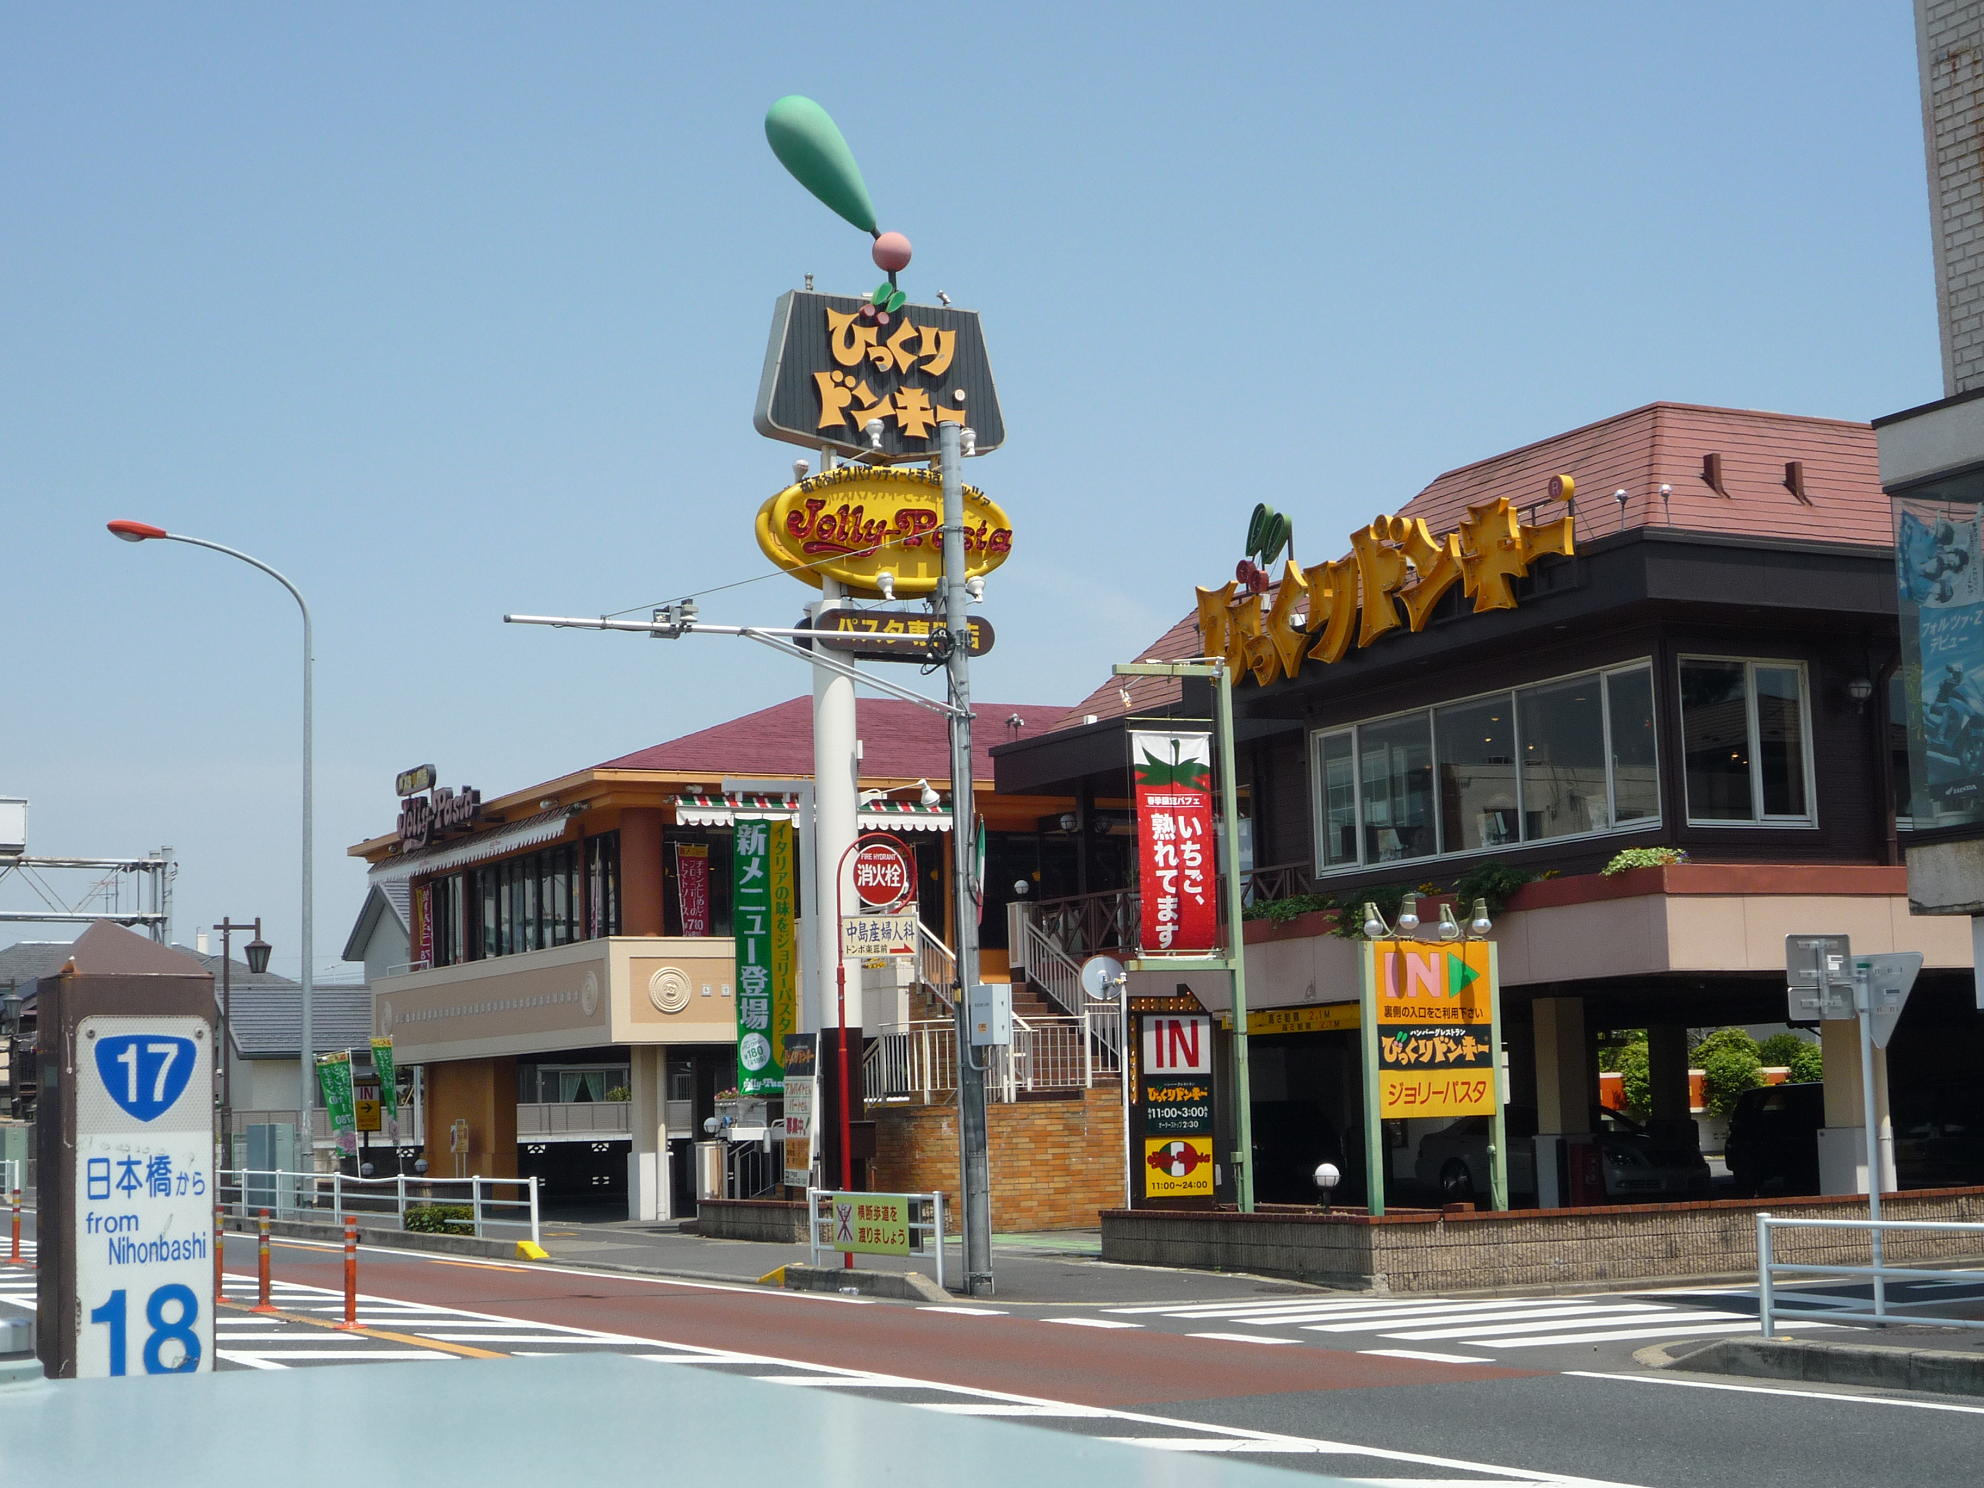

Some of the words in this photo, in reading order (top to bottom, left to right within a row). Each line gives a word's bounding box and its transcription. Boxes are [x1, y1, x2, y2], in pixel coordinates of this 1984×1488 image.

[826, 305, 957, 376] びっくり
[811, 369, 967, 439] ドンキー
[1196, 496, 1574, 688] びっくりドンキー
[873, 853, 897, 861] HYDRANT
[1177, 815, 1205, 906] いちご、
[857, 863, 902, 887] 消火栓
[1150, 813, 1179, 950] 熟れてます
[736, 824, 770, 1031] 新メニュー登場
[846, 920, 915, 943] 中島産婦人科
[1384, 952, 1441, 998] IN
[1384, 1005, 1484, 1020] 裏側の入口をご利用下さい
[1155, 1019, 1199, 1068] IN
[1409, 1028, 1466, 1037] ハンバーグレストラン
[1381, 1035, 1489, 1066] びっくりドンキー
[117, 1043, 179, 1103] 17
[360, 1087, 374, 1100] IN
[1147, 1087, 1208, 1102] びっくりドンキー
[1387, 1081, 1487, 1106] ジョリーパスタ
[86, 1154, 206, 1201] 日本橋から
[86, 1211, 140, 1235] from
[857, 1204, 898, 1222] 横断歩道を
[108, 1231, 206, 1265] Nihonbashi
[858, 1226, 906, 1245] 渡りましょう
[91, 1284, 202, 1377] 18
